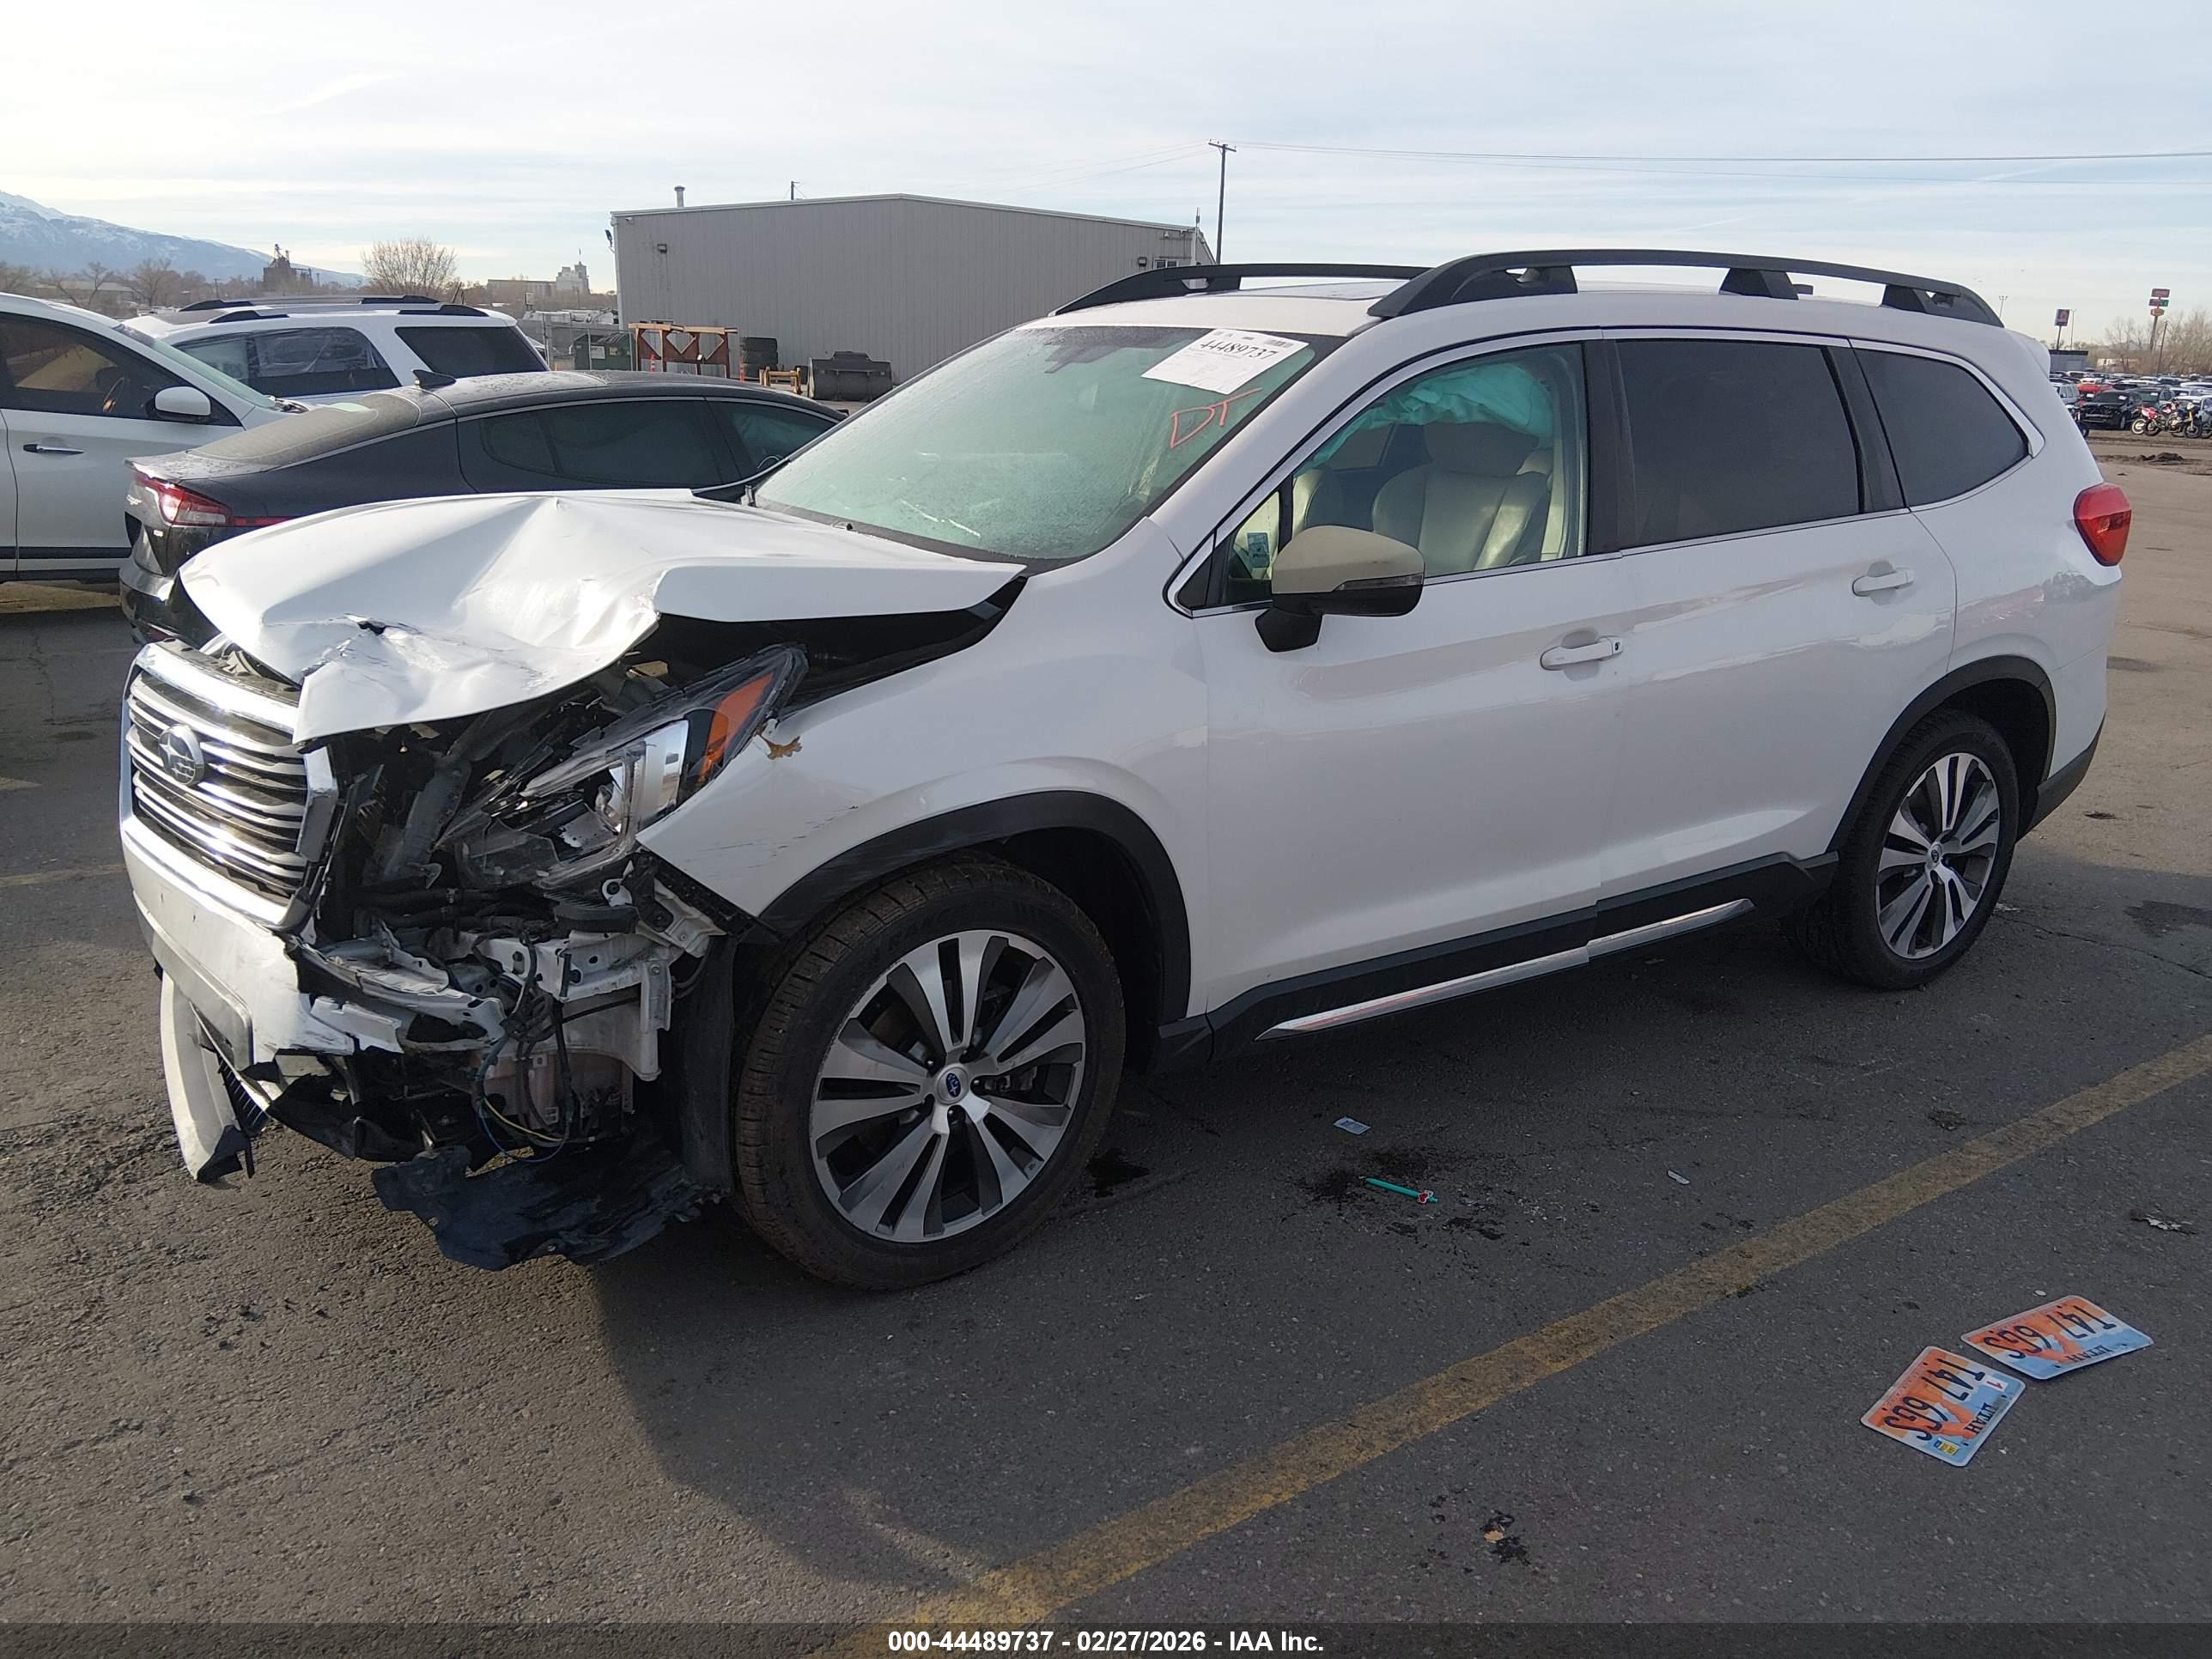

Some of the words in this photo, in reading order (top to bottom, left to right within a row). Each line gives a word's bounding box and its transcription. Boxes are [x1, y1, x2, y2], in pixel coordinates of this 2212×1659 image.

[1200, 339, 1279, 360] 44489737
[2066, 1345, 2113, 1364] UTAH
[1964, 1402, 1994, 1435] UTAH
